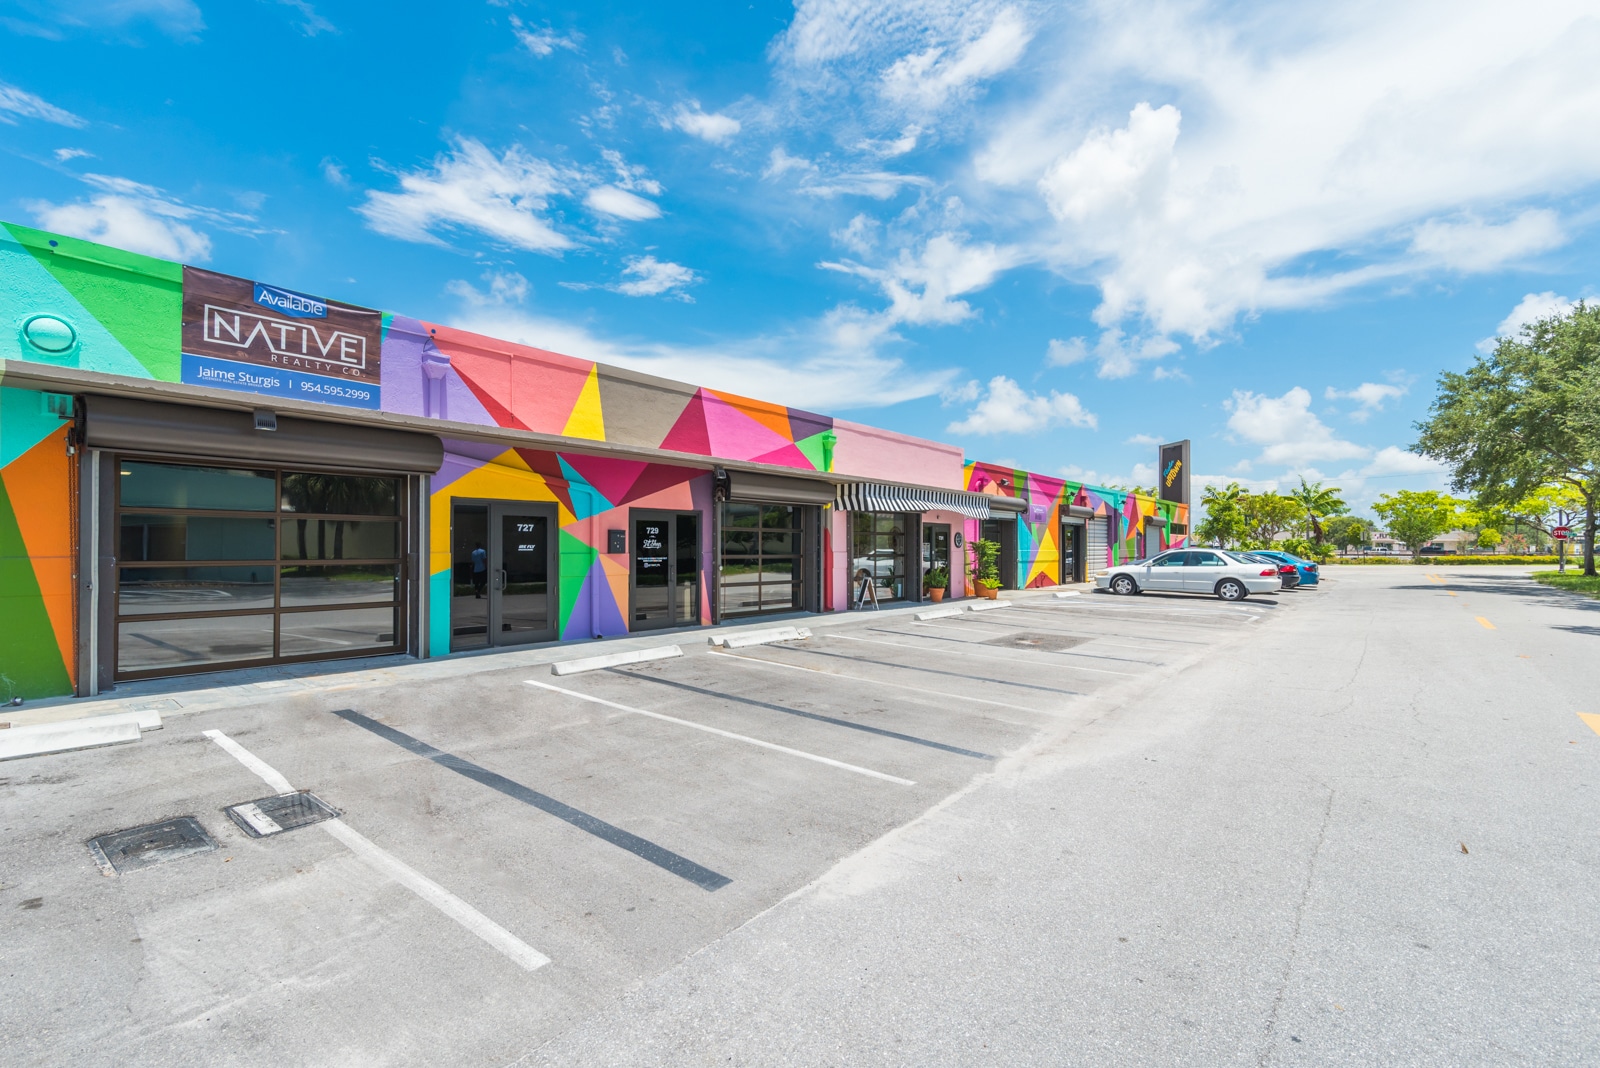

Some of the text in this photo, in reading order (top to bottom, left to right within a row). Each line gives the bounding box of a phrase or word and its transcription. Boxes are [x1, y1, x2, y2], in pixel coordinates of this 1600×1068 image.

[258, 290, 323, 316] Available
[213, 311, 359, 364] NATIVE
[197, 365, 280, 388] Jaime Sturgis
[271, 354, 366, 378] REALTY CO.
[300, 381, 370, 401] 954.595.2999
[1165, 459, 1182, 488] UPTOWN
[517, 523, 535, 532] 727
[646, 527, 659, 535] 729
